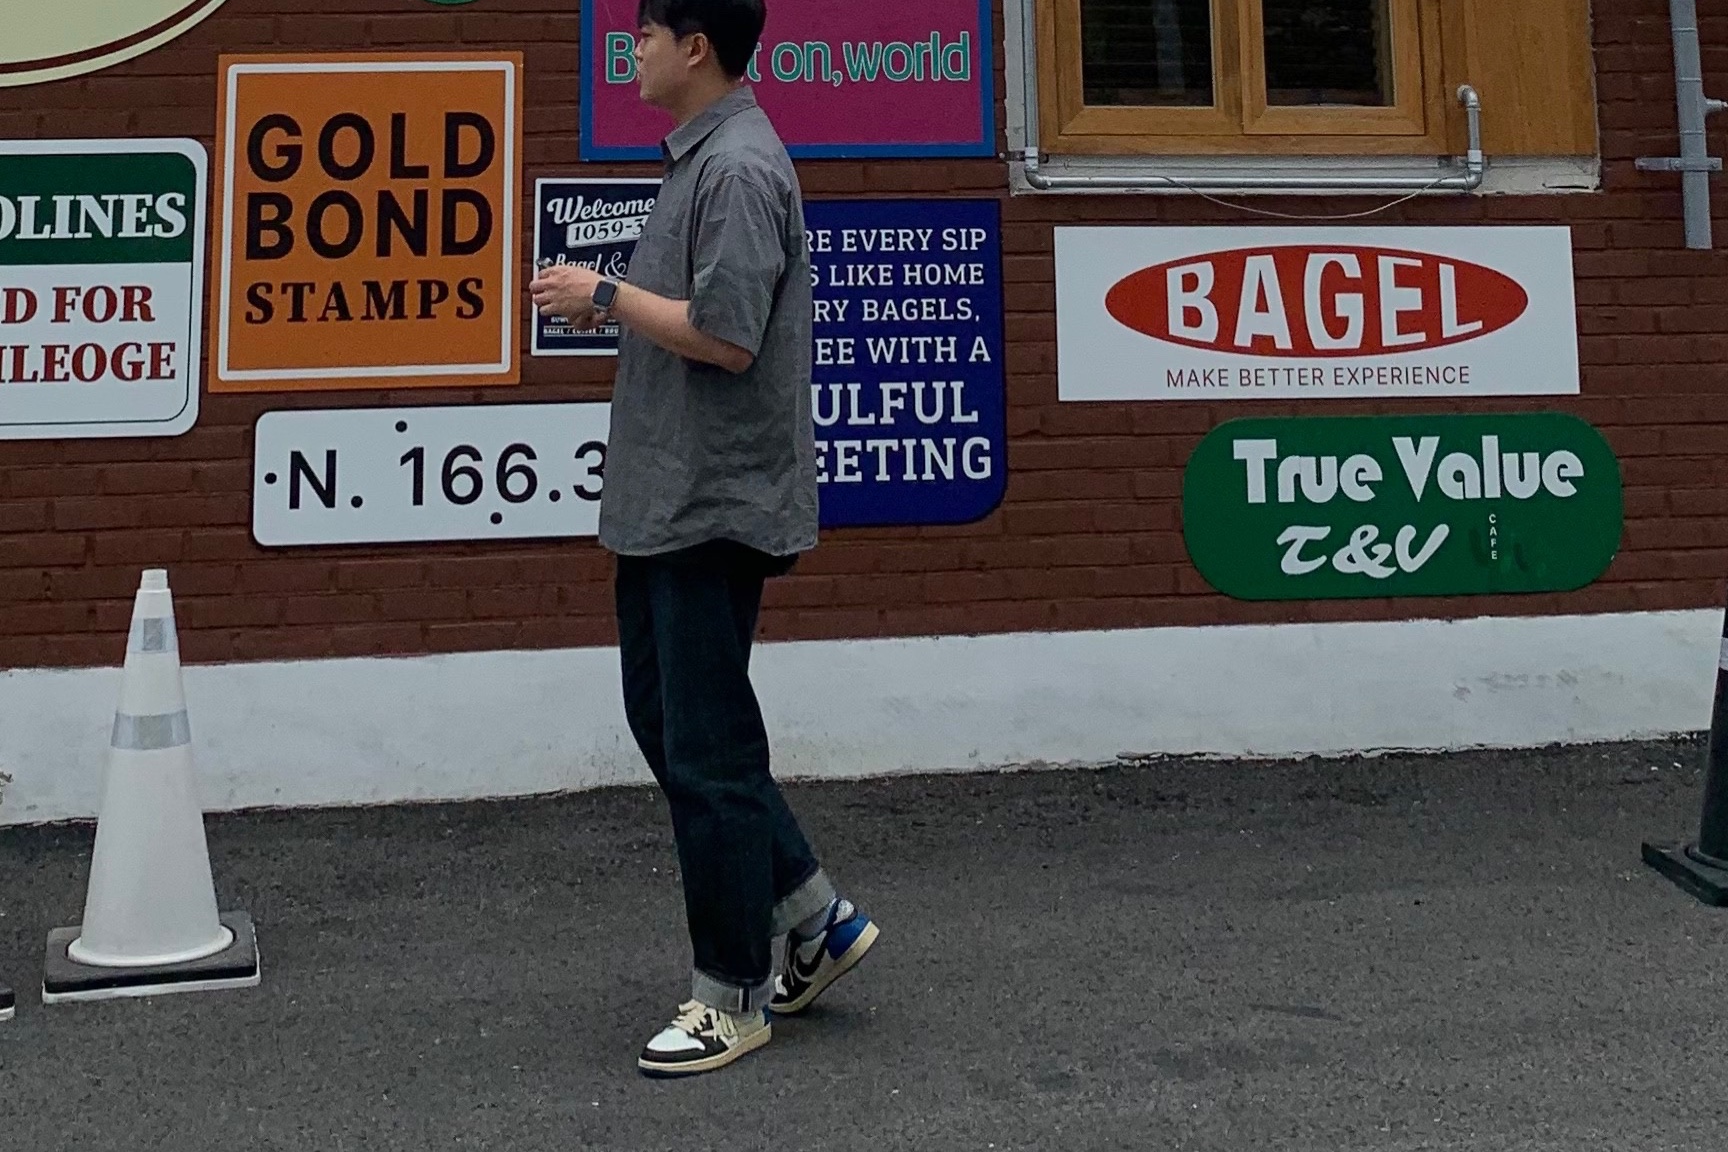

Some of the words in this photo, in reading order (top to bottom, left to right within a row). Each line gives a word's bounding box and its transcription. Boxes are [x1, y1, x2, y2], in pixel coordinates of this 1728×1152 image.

[246, 112, 496, 182] GOLD
[245, 188, 494, 260] BOND
[547, 196, 655, 224] Welcome
[842, 229, 933, 252] EVERY
[942, 229, 987, 251] SIP
[830, 264, 894, 286] LIKE
[903, 264, 985, 285] HOME
[50, 285, 156, 324] FOR
[245, 278, 485, 325] STAMPS
[862, 298, 981, 322] BAGELS,
[1166, 252, 1483, 349] BAGEL
[866, 336, 958, 363] WITH
[969, 336, 992, 362] A
[1167, 368, 1229, 388] MAKE
[1240, 367, 1325, 387] BETTER
[1334, 365, 1471, 386] EXPERIENCE
[400, 440, 608, 506] 166.3
[1232, 438, 1383, 504] True
[1392, 434, 1585, 503] Value
